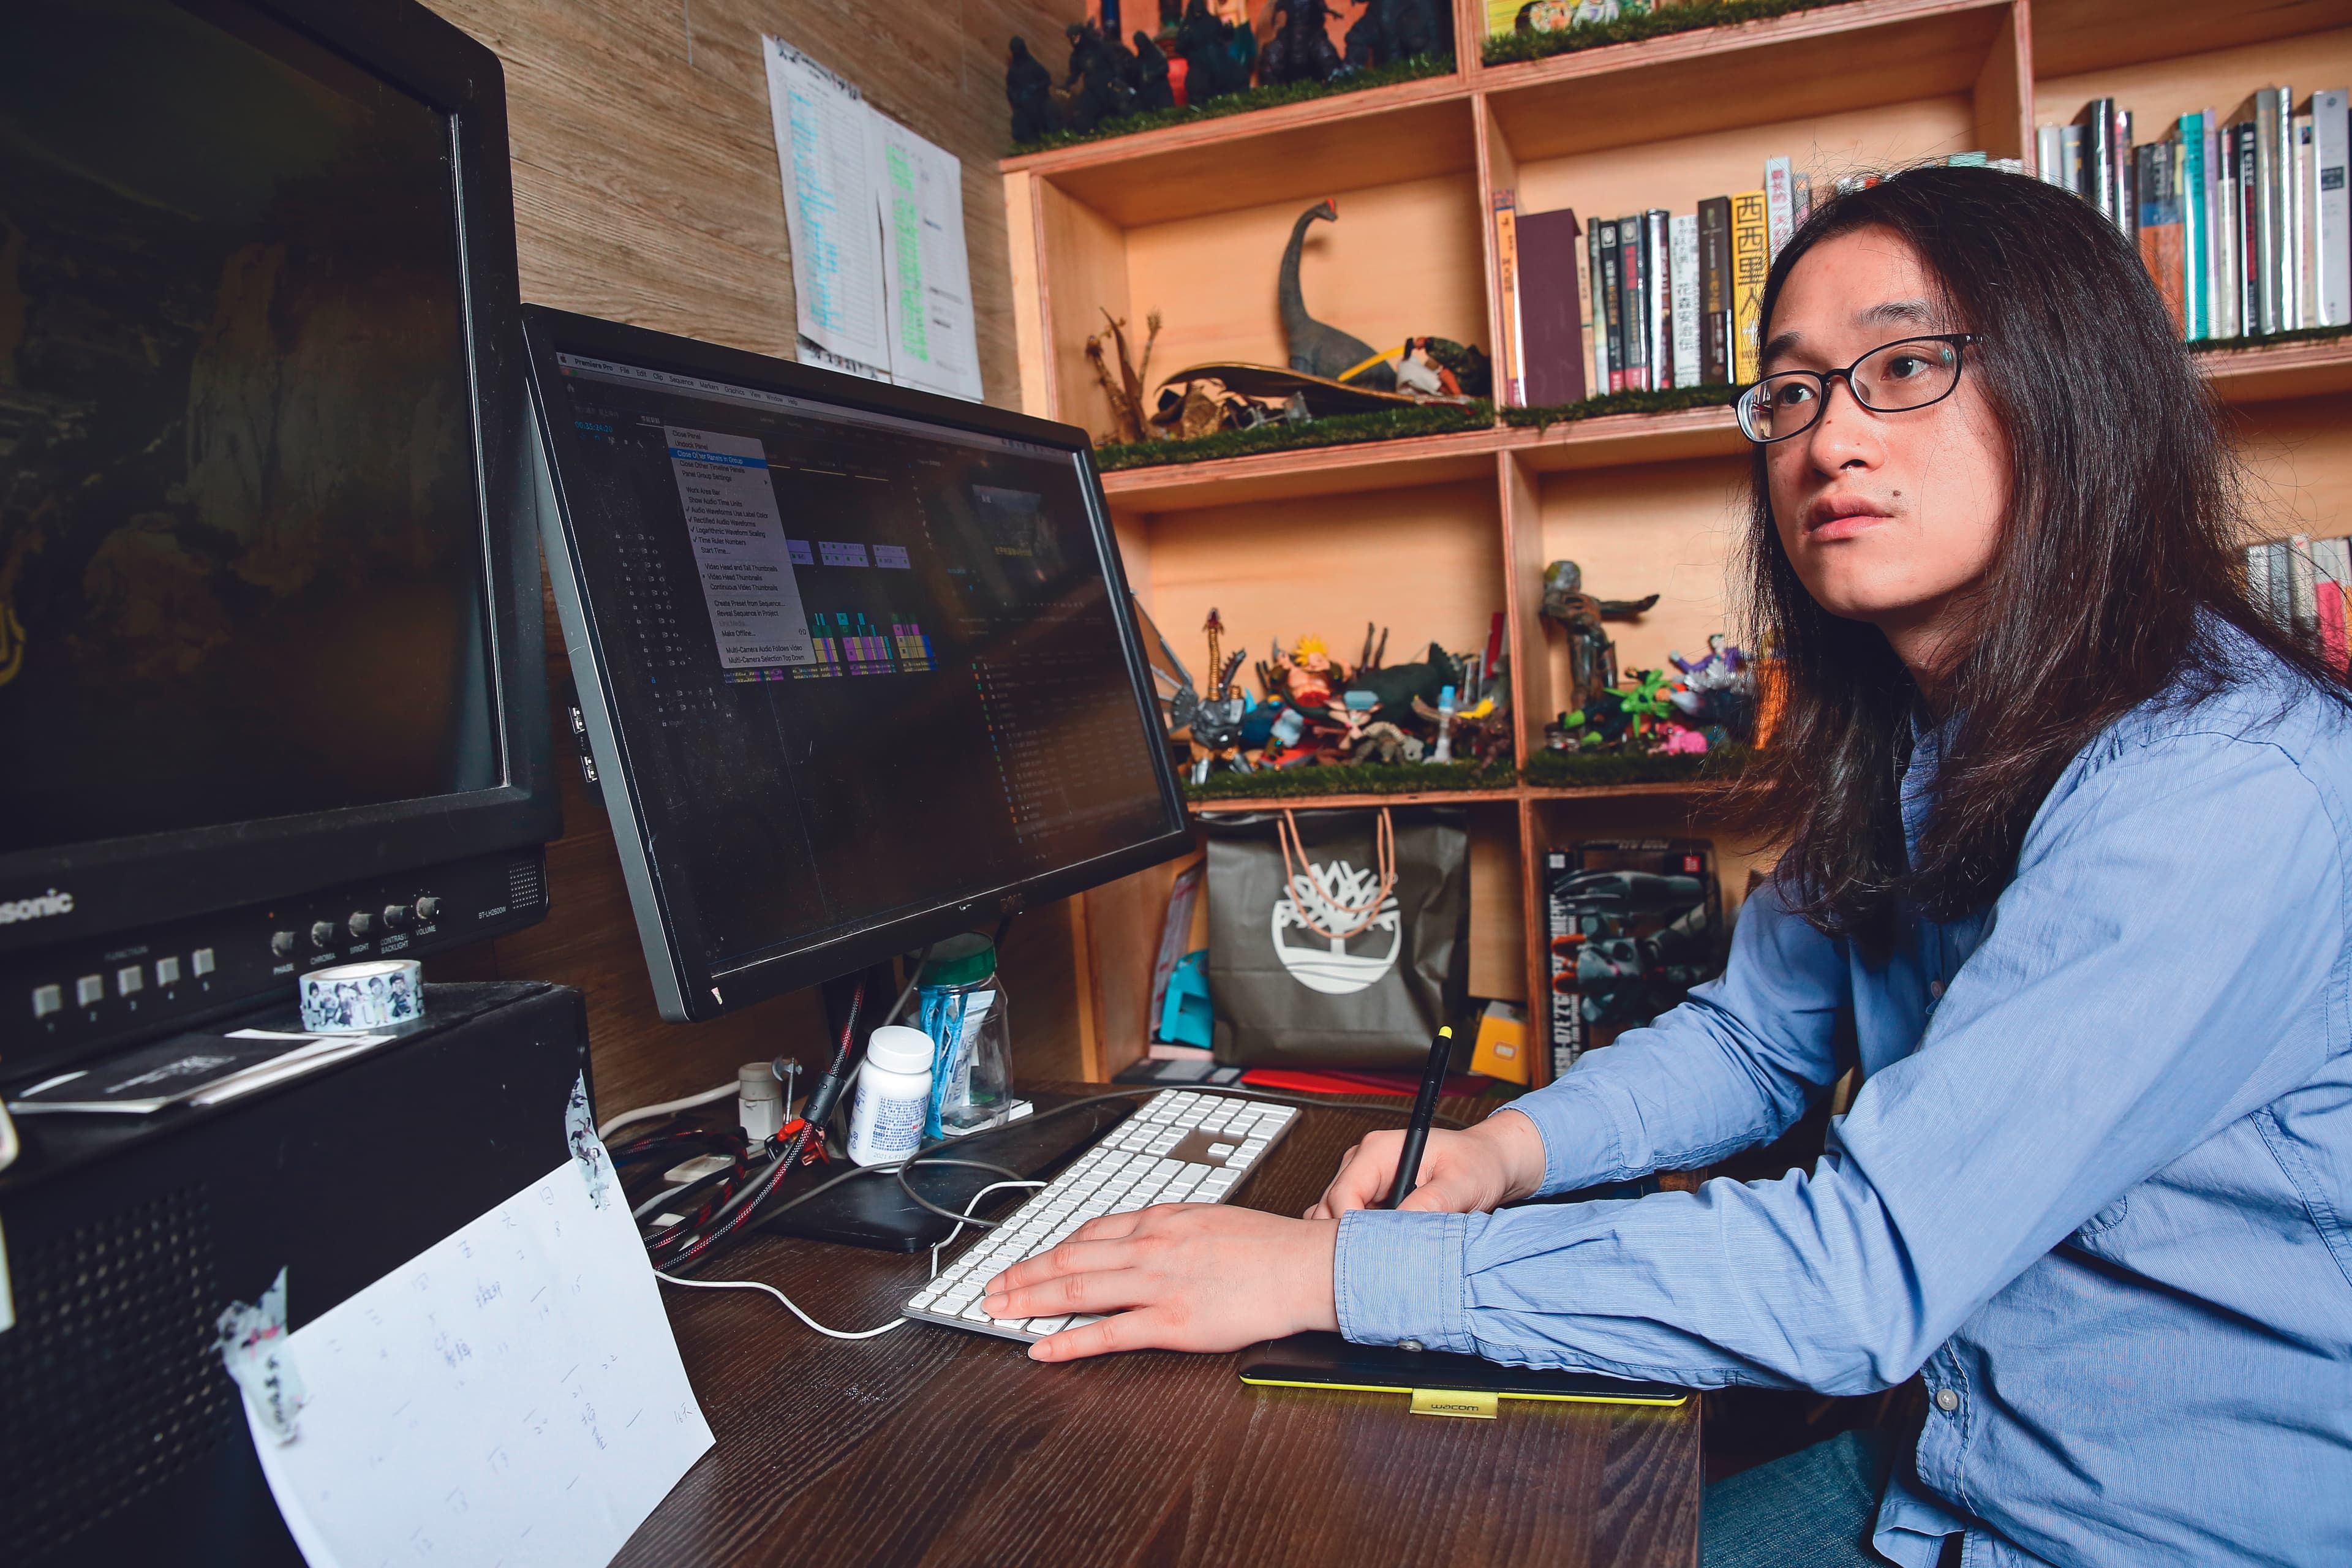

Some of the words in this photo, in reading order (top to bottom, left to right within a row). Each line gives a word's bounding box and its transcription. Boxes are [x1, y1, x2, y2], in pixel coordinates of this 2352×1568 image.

[1736, 195, 1766, 315] 西西里人
[575, 358, 602, 369] Premiere
[653, 372, 663, 381] Clip
[669, 376, 694, 386] Sequence
[699, 382, 719, 391] Markers
[724, 386, 745, 396] Graphics
[766, 394, 783, 402] Window
[788, 397, 798, 405] Help
[709, 463, 729, 472] Timeline
[712, 473, 732, 482] Settings
[706, 508, 733, 516] Waveforms
[693, 516, 715, 525] Rectified
[696, 527, 725, 535] Logarithmic
[0, 888, 74, 925] sonic
[478, 907, 507, 919] BT-LH2600W
[415, 925, 437, 936] VOLUME
[350, 943, 369, 954] BRIGHT
[381, 940, 409, 954] BACKLIGHT
[310, 952, 337, 965] CHROMA
[273, 963, 294, 975] PHASE
[1431, 1403, 1479, 1412] wacom
